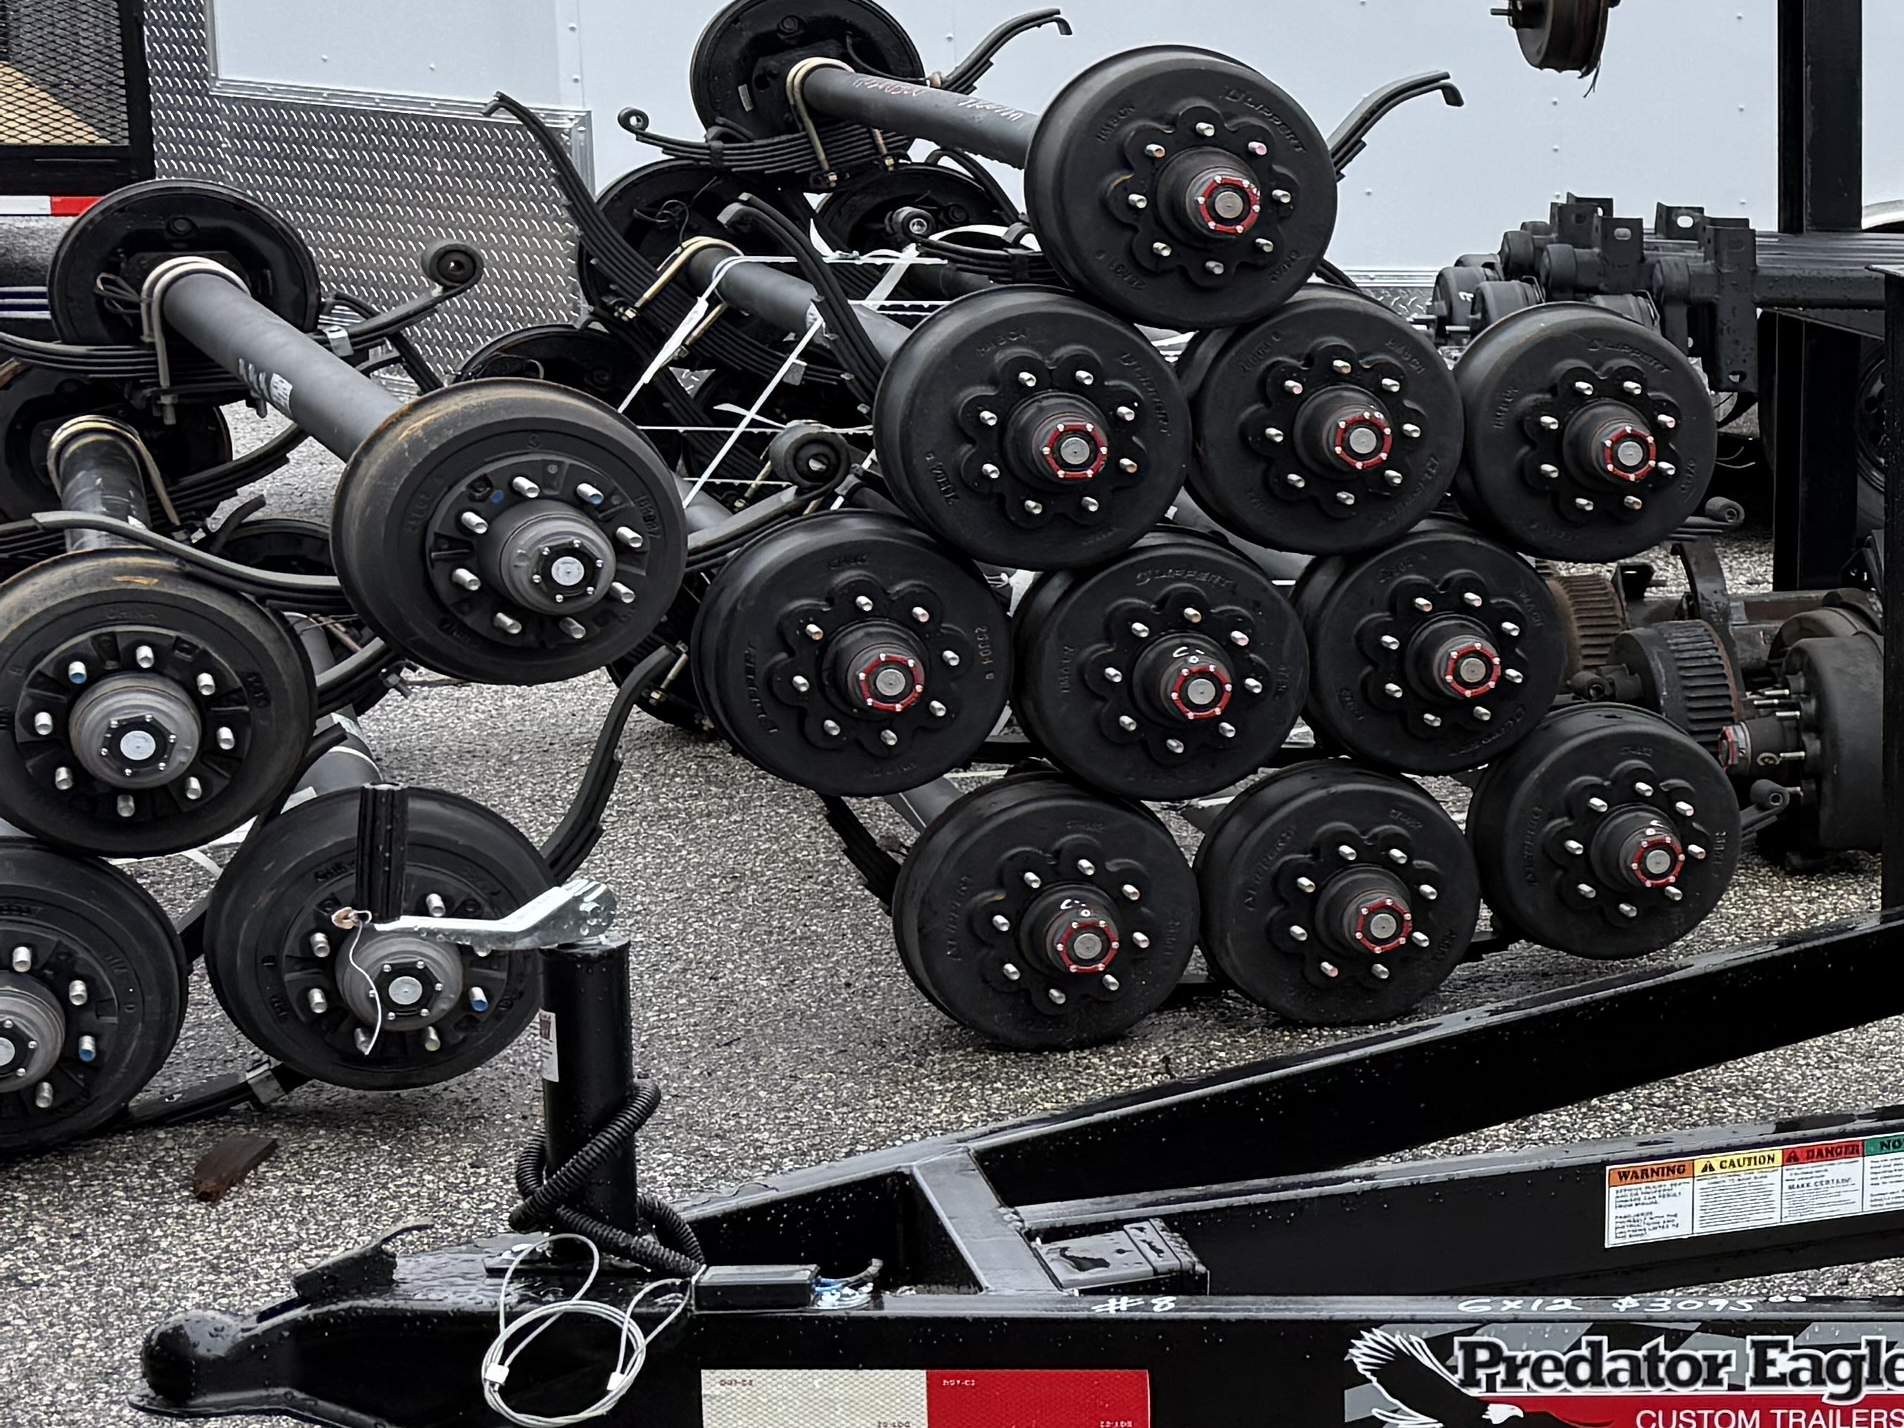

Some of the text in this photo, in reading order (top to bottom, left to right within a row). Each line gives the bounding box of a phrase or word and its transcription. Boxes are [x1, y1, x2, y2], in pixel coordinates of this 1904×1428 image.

[1805, 1144, 1860, 1160] DANGER
[1719, 1154, 1776, 1170] CAUTION
[1617, 1164, 1686, 1182] WARNING
[1454, 1337, 1734, 1392] Predator
